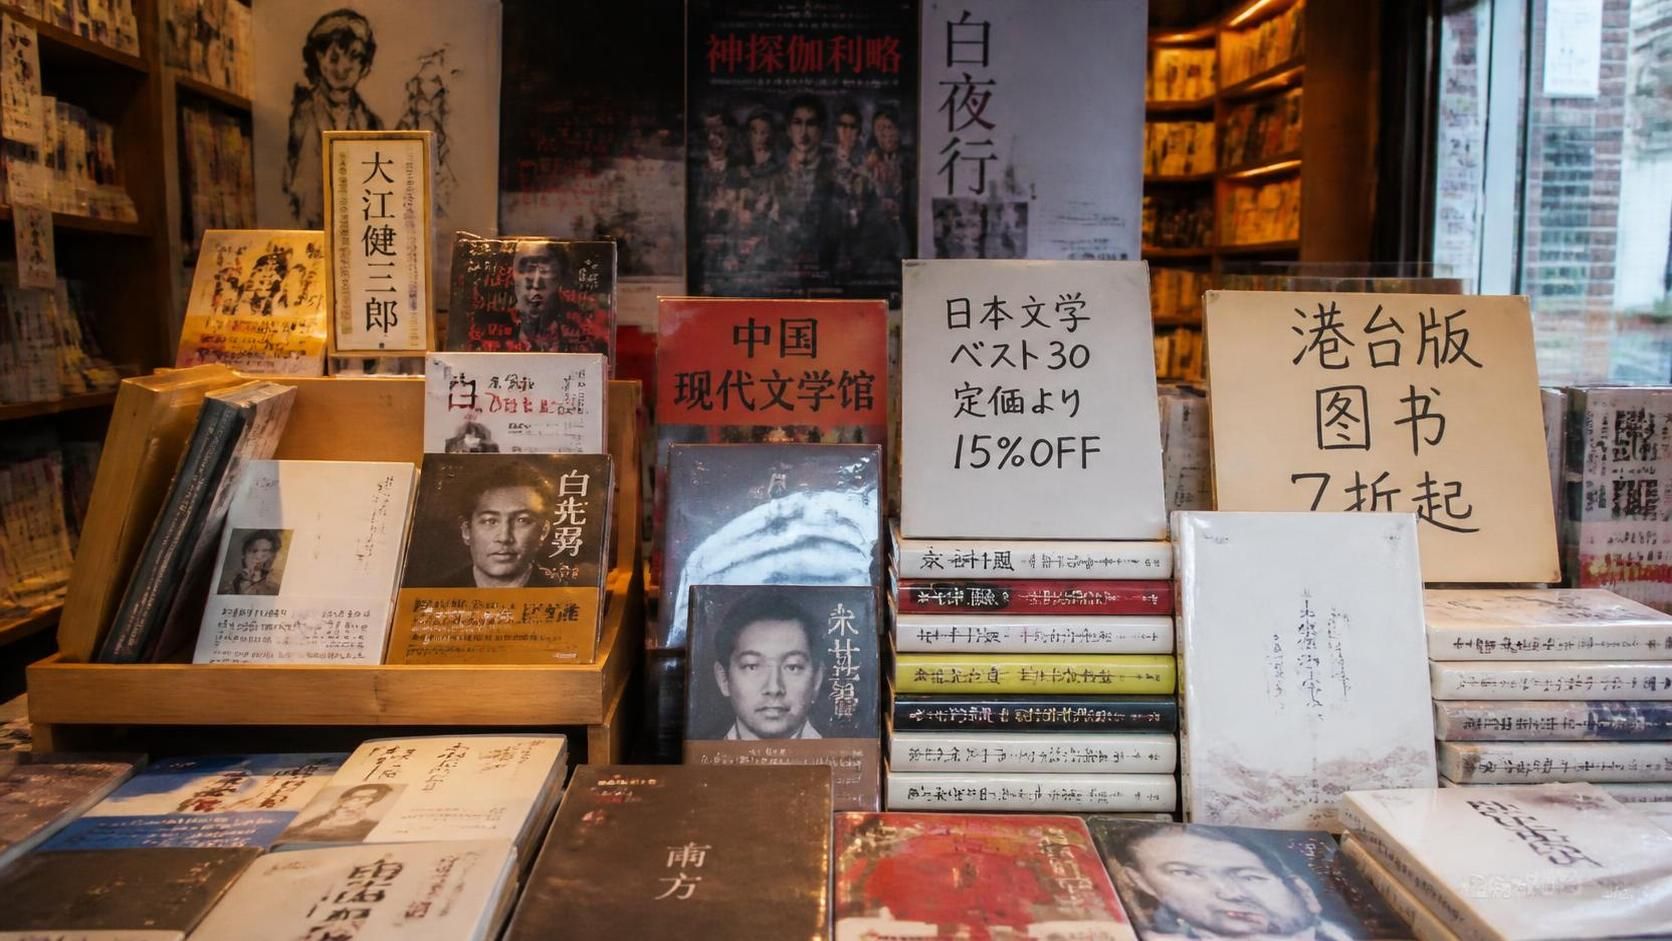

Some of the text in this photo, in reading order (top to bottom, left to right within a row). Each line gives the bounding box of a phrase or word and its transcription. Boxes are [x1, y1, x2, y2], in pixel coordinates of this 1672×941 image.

[706, 32, 901, 74] 神探伽利略
[937, 10, 999, 198] 白夜行
[361, 151, 398, 334] 大江健三郎
[946, 292, 1091, 333] 日本文学
[732, 317, 818, 359] 中国
[950, 339, 1090, 371] ベスト30
[1291, 300, 1483, 370] 港台版
[673, 368, 876, 413] 现代文学馆
[953, 381, 1080, 418] 定価より
[1315, 384, 1446, 457] 图书
[954, 434, 1101, 470] 15%OFF
[1290, 470, 1481, 533] 7折起
